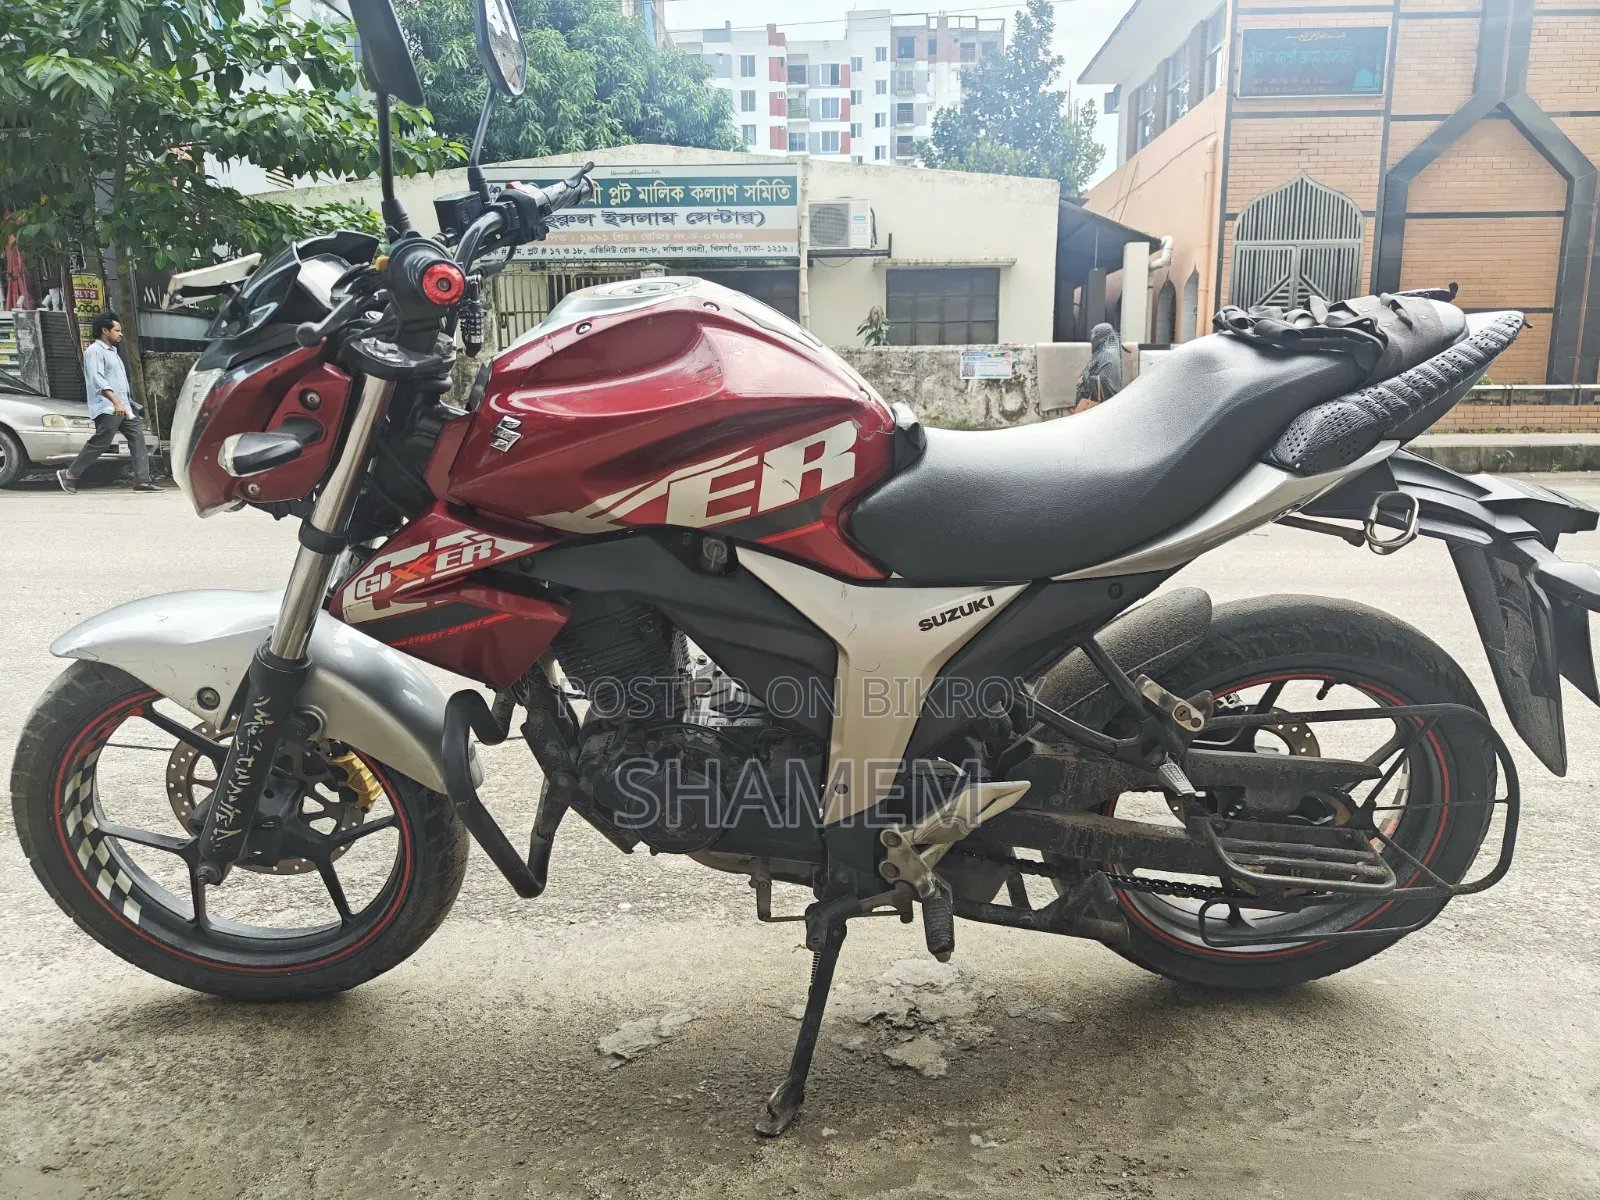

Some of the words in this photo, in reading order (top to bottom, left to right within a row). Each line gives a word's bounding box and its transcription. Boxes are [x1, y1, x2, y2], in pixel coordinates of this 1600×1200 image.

[608, 181, 633, 206] প্লট
[636, 180, 685, 203] মালিক
[689, 182, 738, 203] কল্যাণ
[742, 178, 792, 202] সমিতি
[601, 209, 679, 227] ইসলাম
[589, 245, 617, 254] এভিনিউ
[620, 246, 636, 254] রোড
[663, 244, 683, 253] দক্ষিণ
[355, 538, 494, 600] GIXXER
[918, 594, 995, 632] SUZUKI
[407, 631, 444, 645] STREET
[447, 619, 483, 636] SPORT
